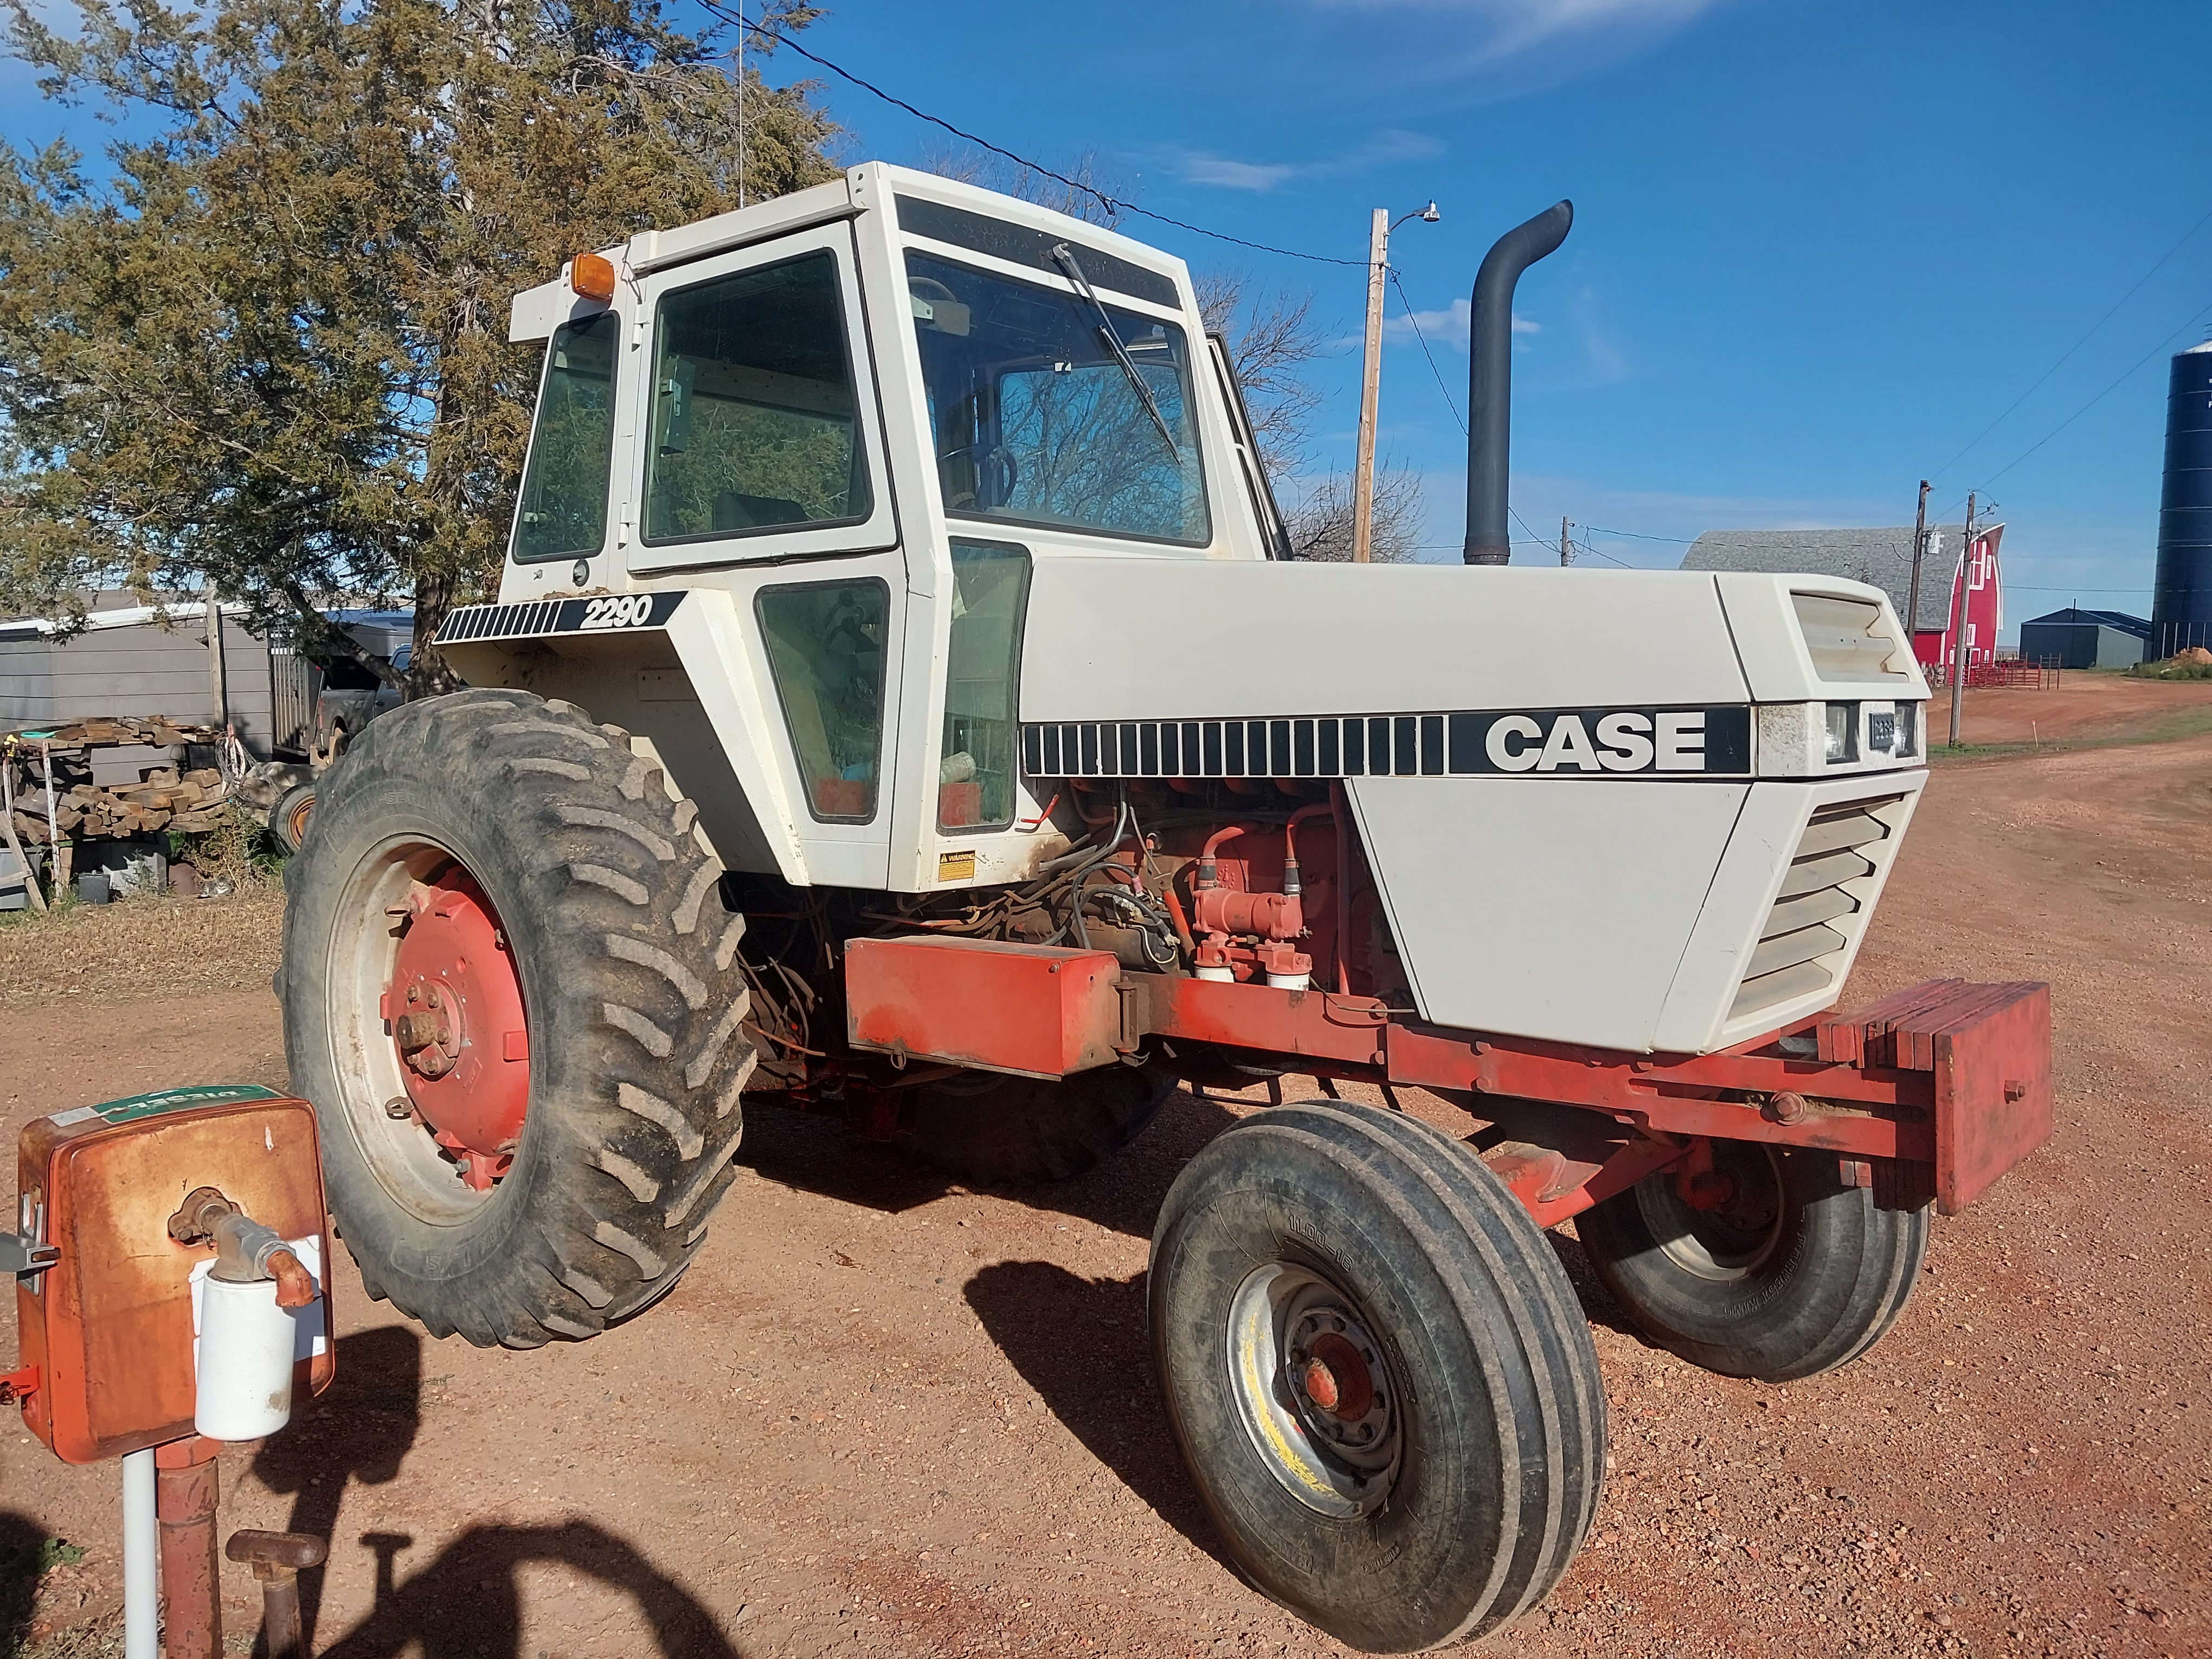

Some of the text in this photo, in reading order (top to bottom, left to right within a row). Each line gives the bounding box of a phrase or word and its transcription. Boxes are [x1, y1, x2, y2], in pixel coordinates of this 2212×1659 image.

[580, 595, 653, 629] 2290
[1485, 712, 1705, 771] CASE
[949, 853, 975, 861] WARNING
[128, 1091, 240, 1109] DIESEL
[1288, 1214, 1354, 1272] 11.00-16
[1724, 1296, 1761, 1319] KING
